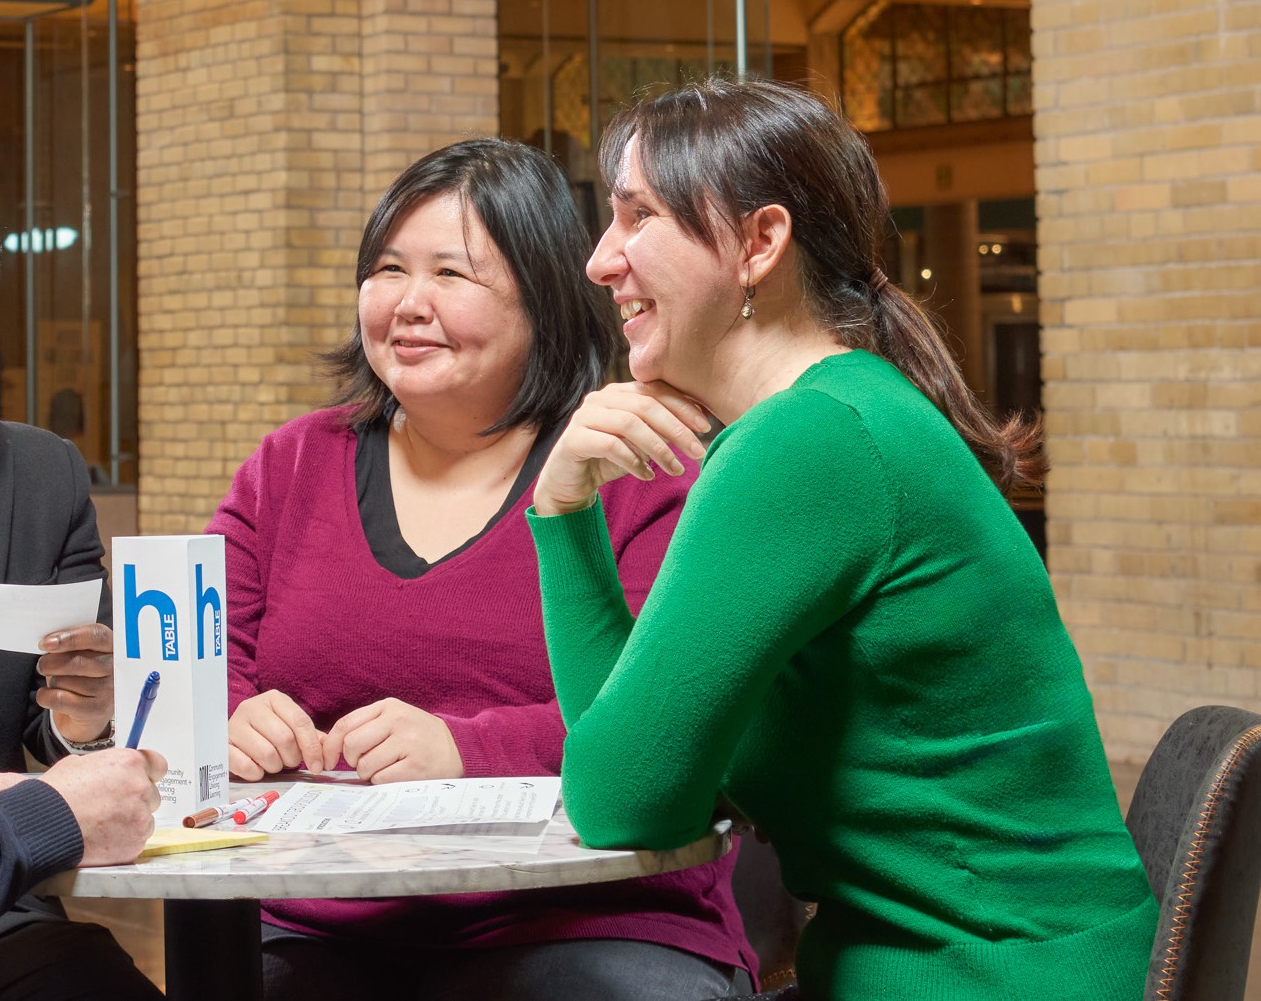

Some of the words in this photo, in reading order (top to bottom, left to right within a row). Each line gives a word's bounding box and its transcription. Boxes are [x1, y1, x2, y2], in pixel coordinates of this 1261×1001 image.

[123, 563, 179, 661] h
[163, 613, 176, 658] TABLE
[195, 563, 222, 660] h
